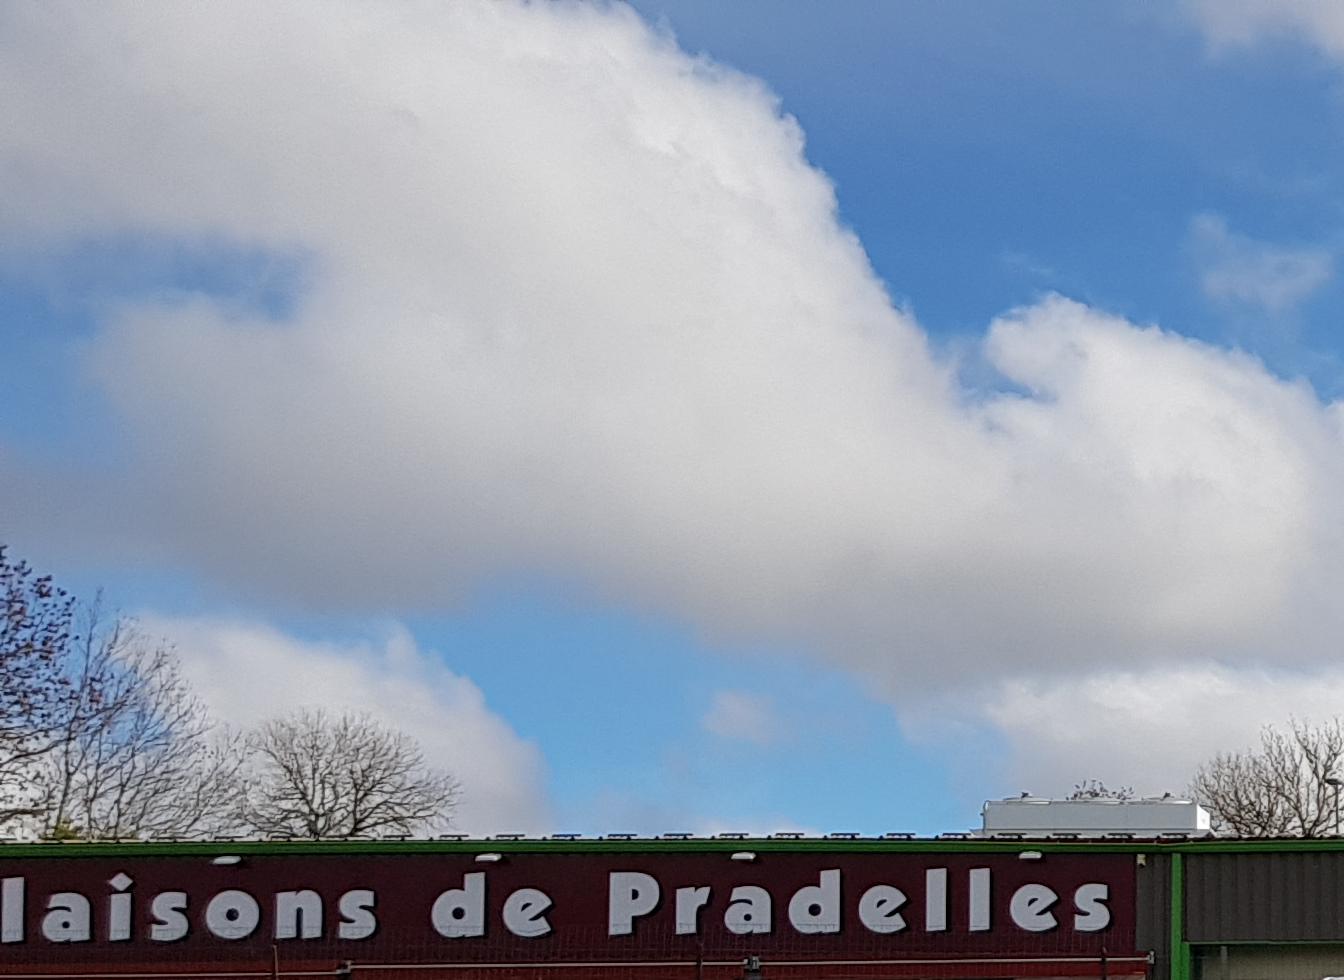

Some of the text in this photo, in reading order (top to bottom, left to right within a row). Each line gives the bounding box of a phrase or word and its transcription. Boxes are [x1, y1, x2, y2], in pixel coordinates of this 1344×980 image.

[1, 867, 1110, 943] laisons de Pradelles
